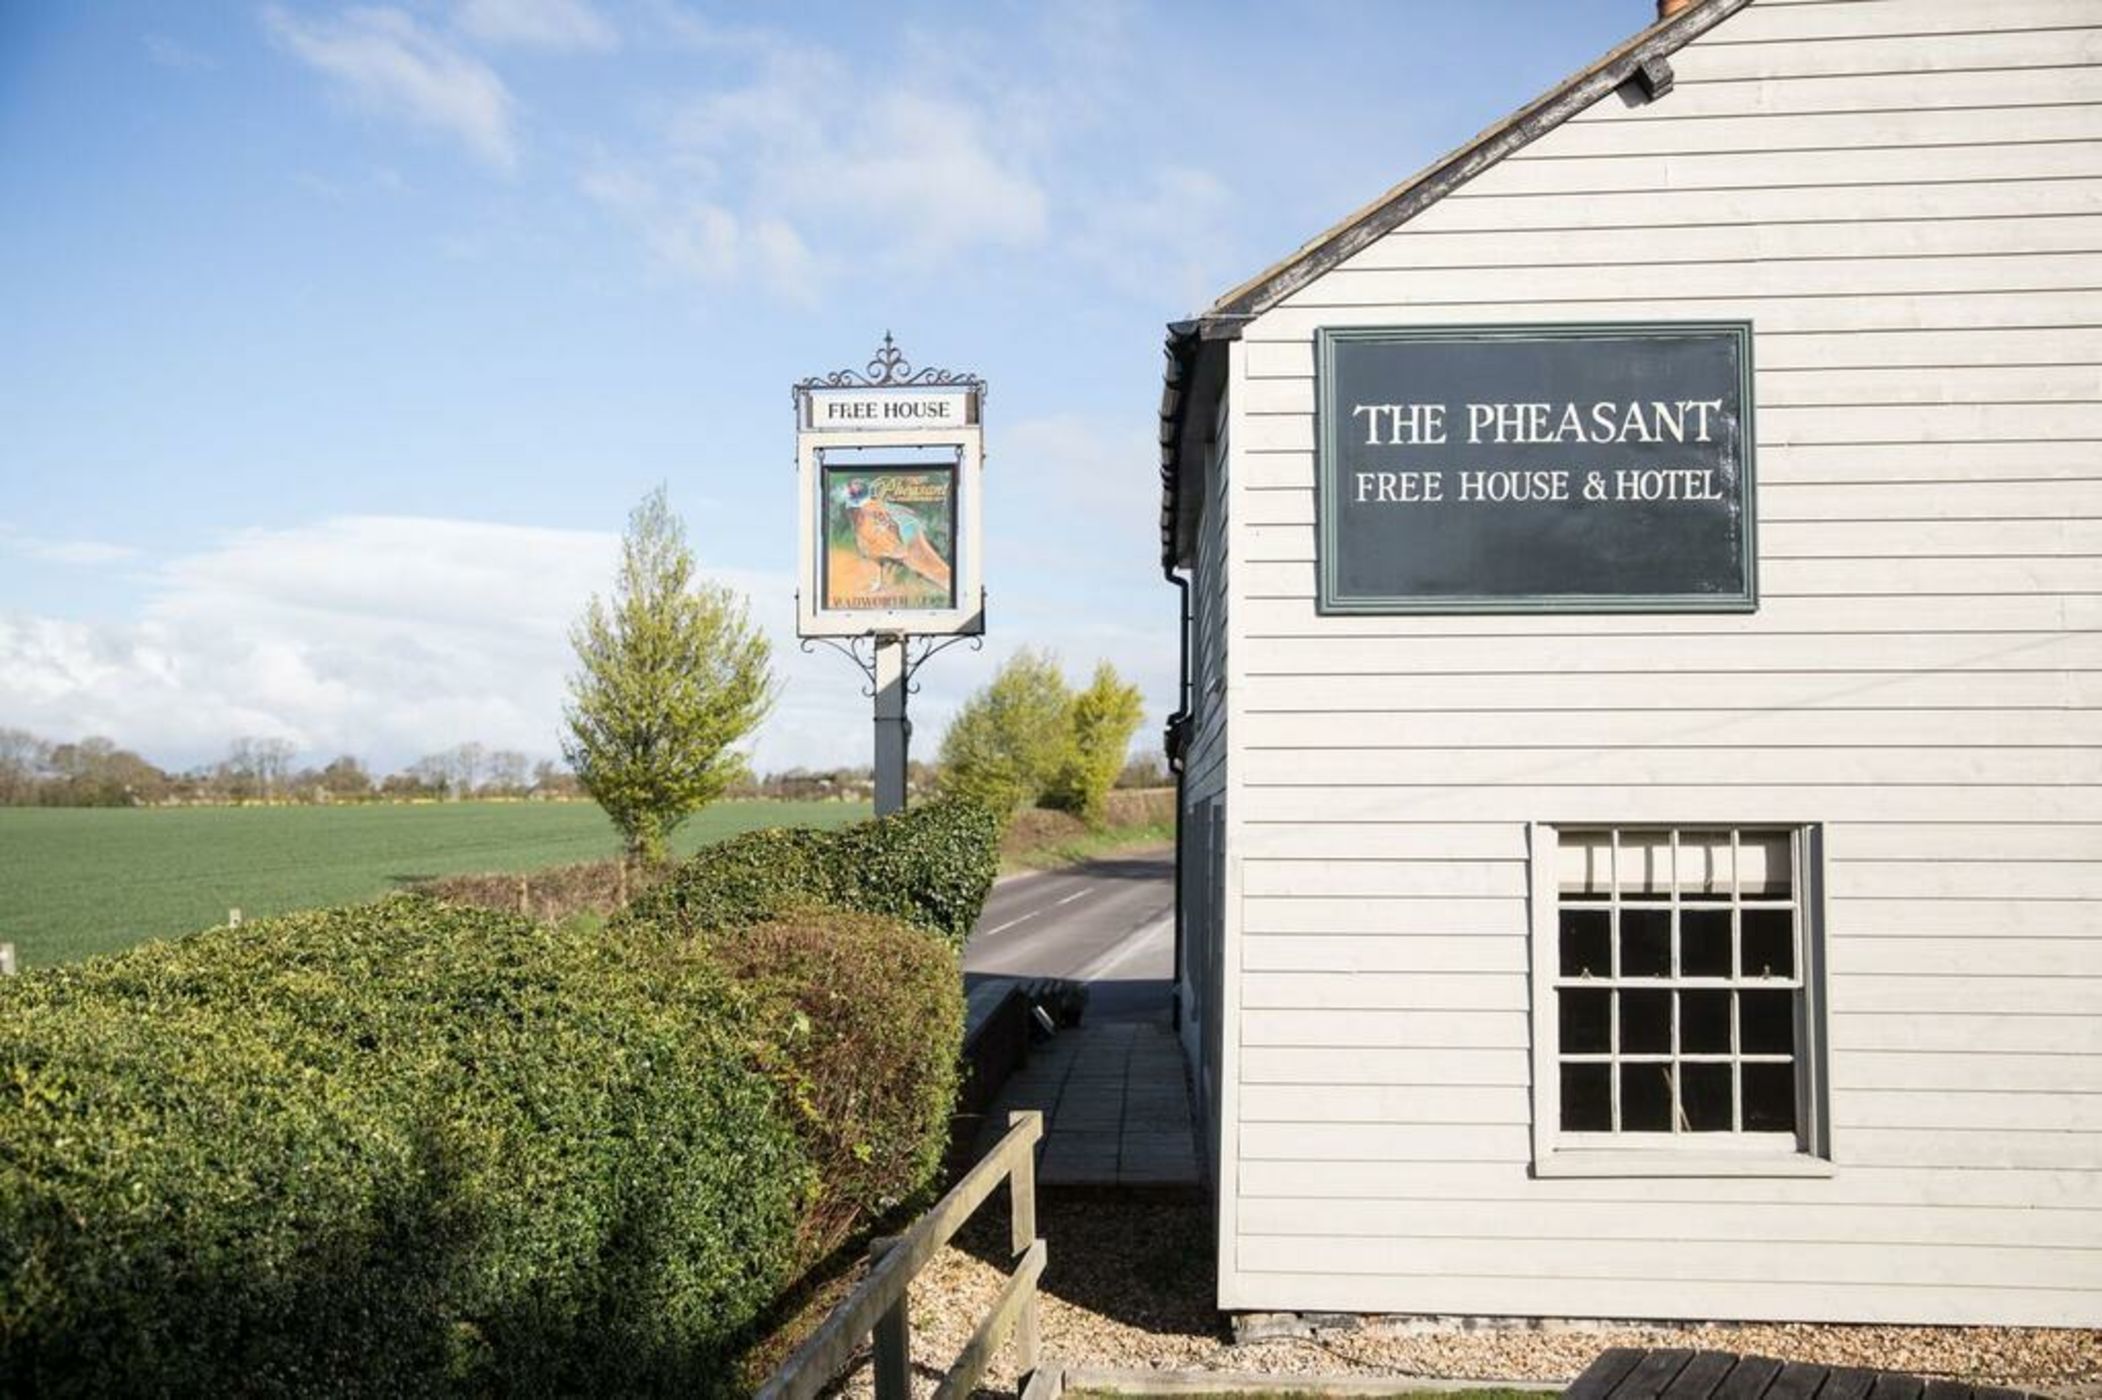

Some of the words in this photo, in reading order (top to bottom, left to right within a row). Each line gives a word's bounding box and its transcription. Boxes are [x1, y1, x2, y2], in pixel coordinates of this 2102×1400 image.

[828, 402, 878, 419] FREE
[884, 401, 950, 418] HOUSE
[1353, 404, 1447, 445] THE
[1466, 399, 1722, 444] PHEASANT
[1356, 472, 1443, 501] FREE
[1458, 471, 1569, 501] HOUSE
[1582, 471, 1608, 500] &
[1615, 469, 1722, 500] HOTEL
